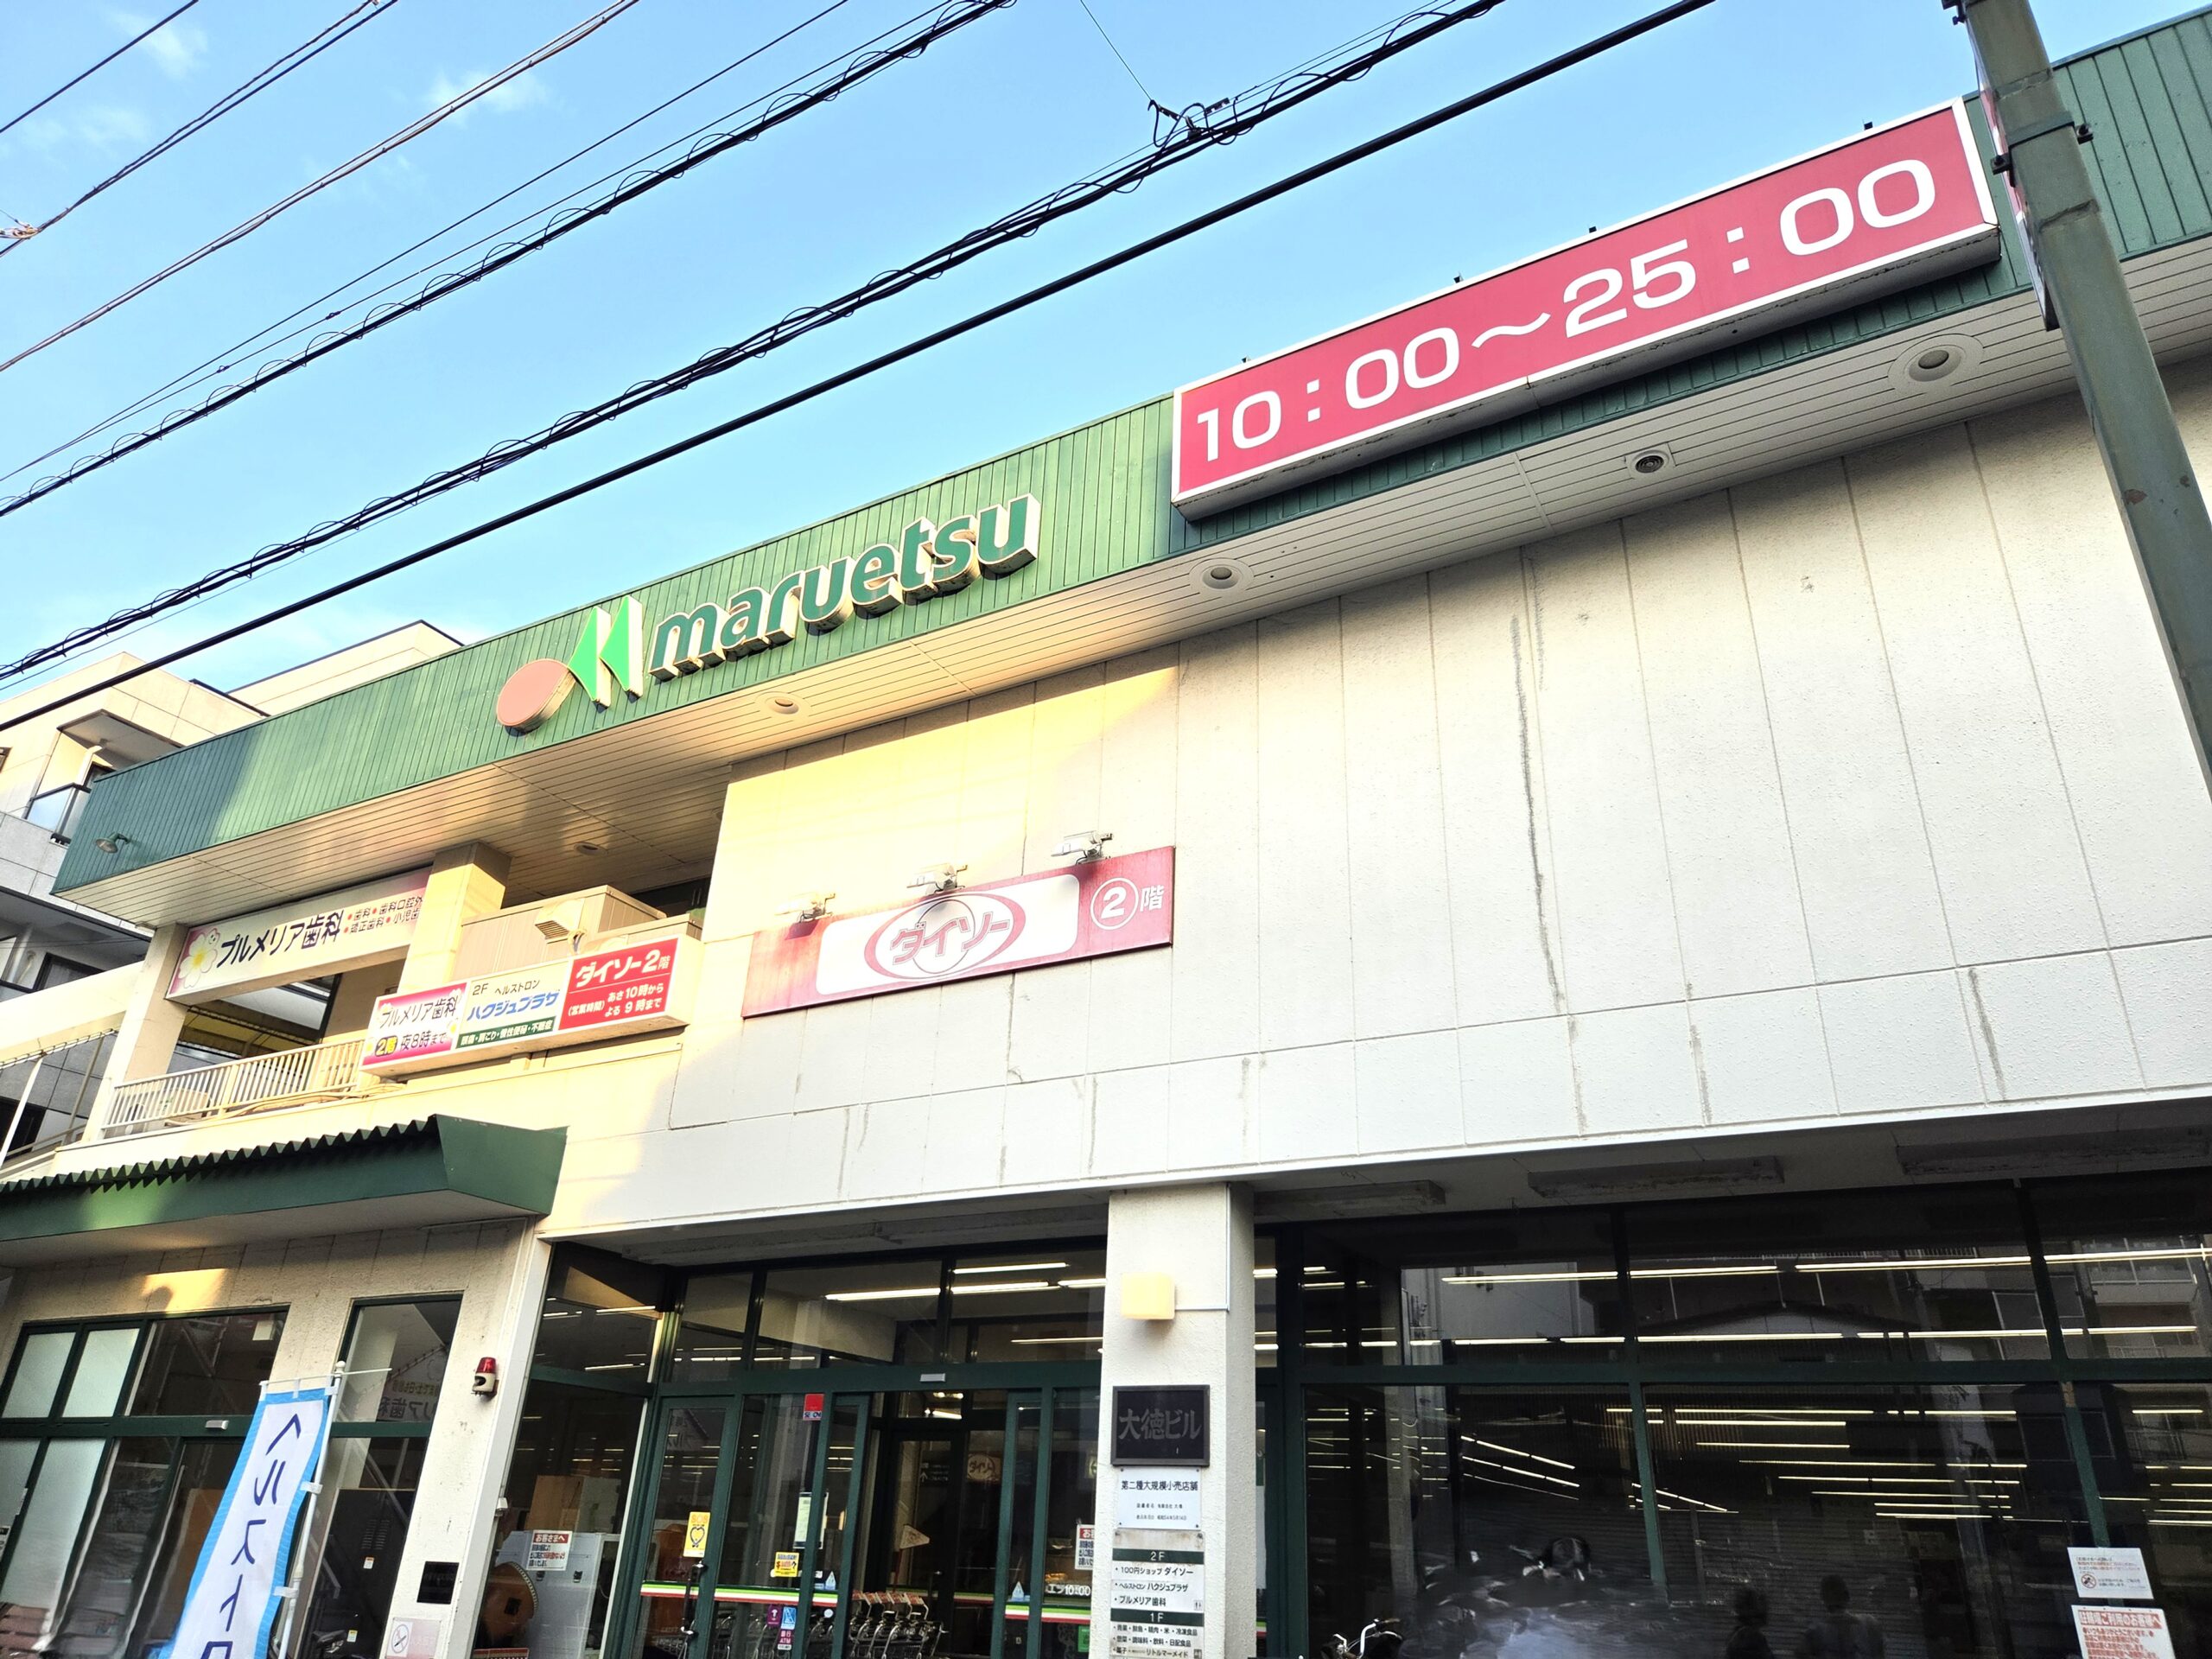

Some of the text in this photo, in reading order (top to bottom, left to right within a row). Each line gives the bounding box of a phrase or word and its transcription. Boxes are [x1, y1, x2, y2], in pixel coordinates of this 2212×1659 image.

[650, 493, 1040, 680] maruetsu
[217, 909, 344, 968] プルメリア歯科
[890, 912, 1011, 966] ダイソー
[473, 980, 541, 996] 2F ヘルストロン
[1150, 1551, 1166, 1560] 2F
[1165, 1567, 1193, 1576] ダイソー
[1150, 1613, 1164, 1622] 1F
